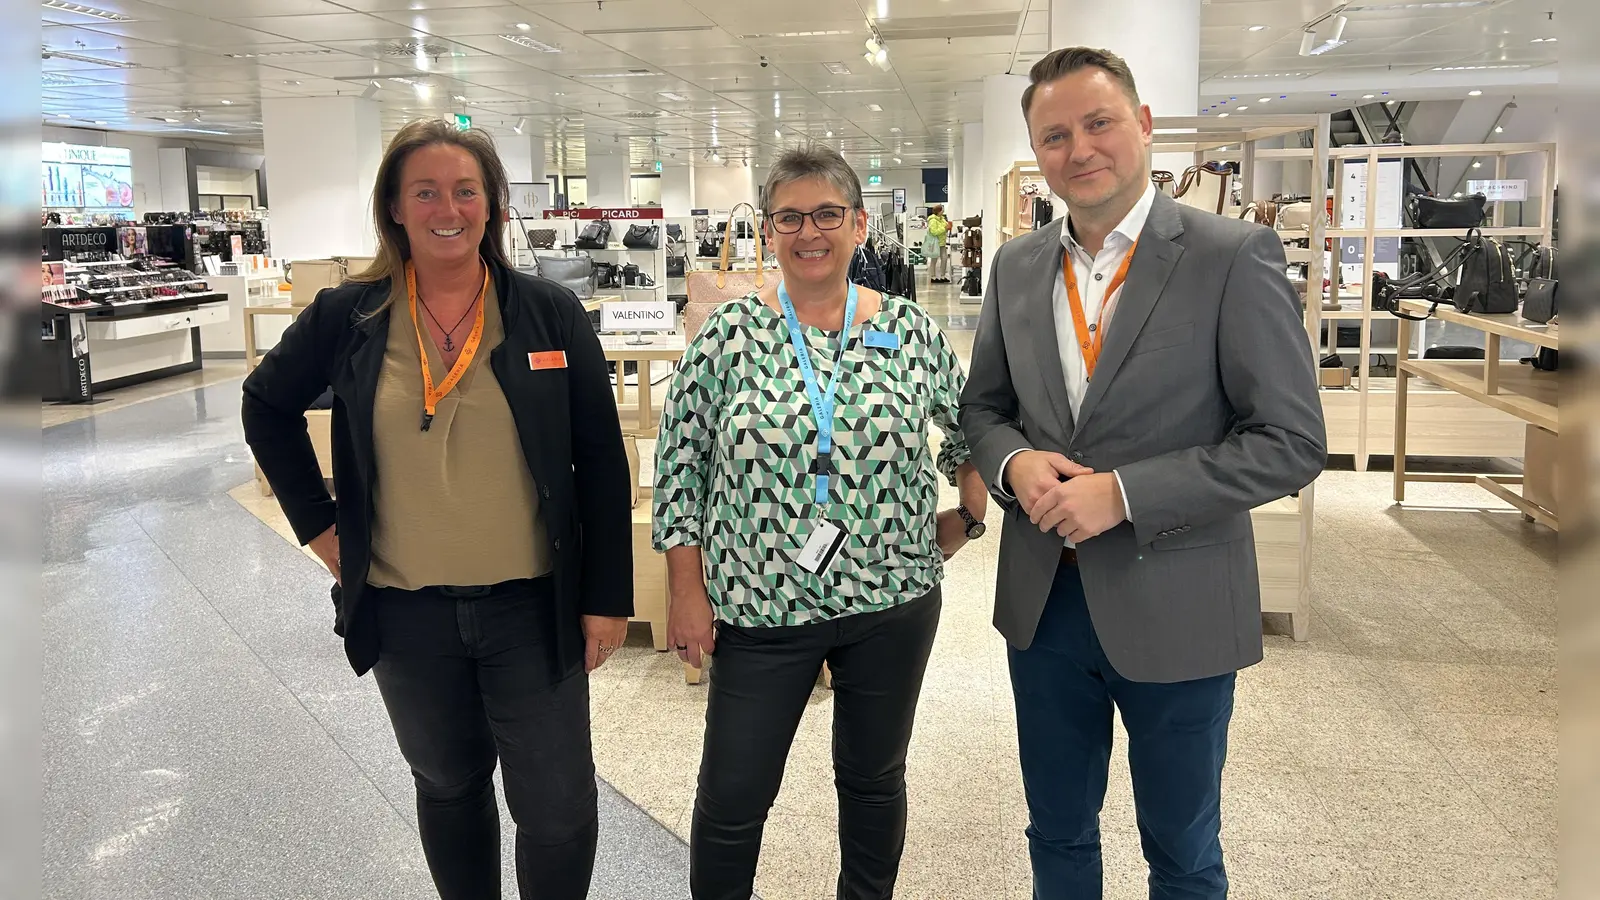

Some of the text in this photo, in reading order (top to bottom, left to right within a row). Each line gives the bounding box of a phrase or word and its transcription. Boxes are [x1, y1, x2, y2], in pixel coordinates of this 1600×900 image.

[601, 210, 640, 218] PICARD
[62, 232, 107, 246] ARTDECO
[1347, 245, 1356, 254] 0
[612, 310, 665, 320] VALENTINO
[798, 347, 809, 370] GALERIA
[78, 358, 88, 397] ARTDECO
[814, 396, 825, 420] GALERIA
